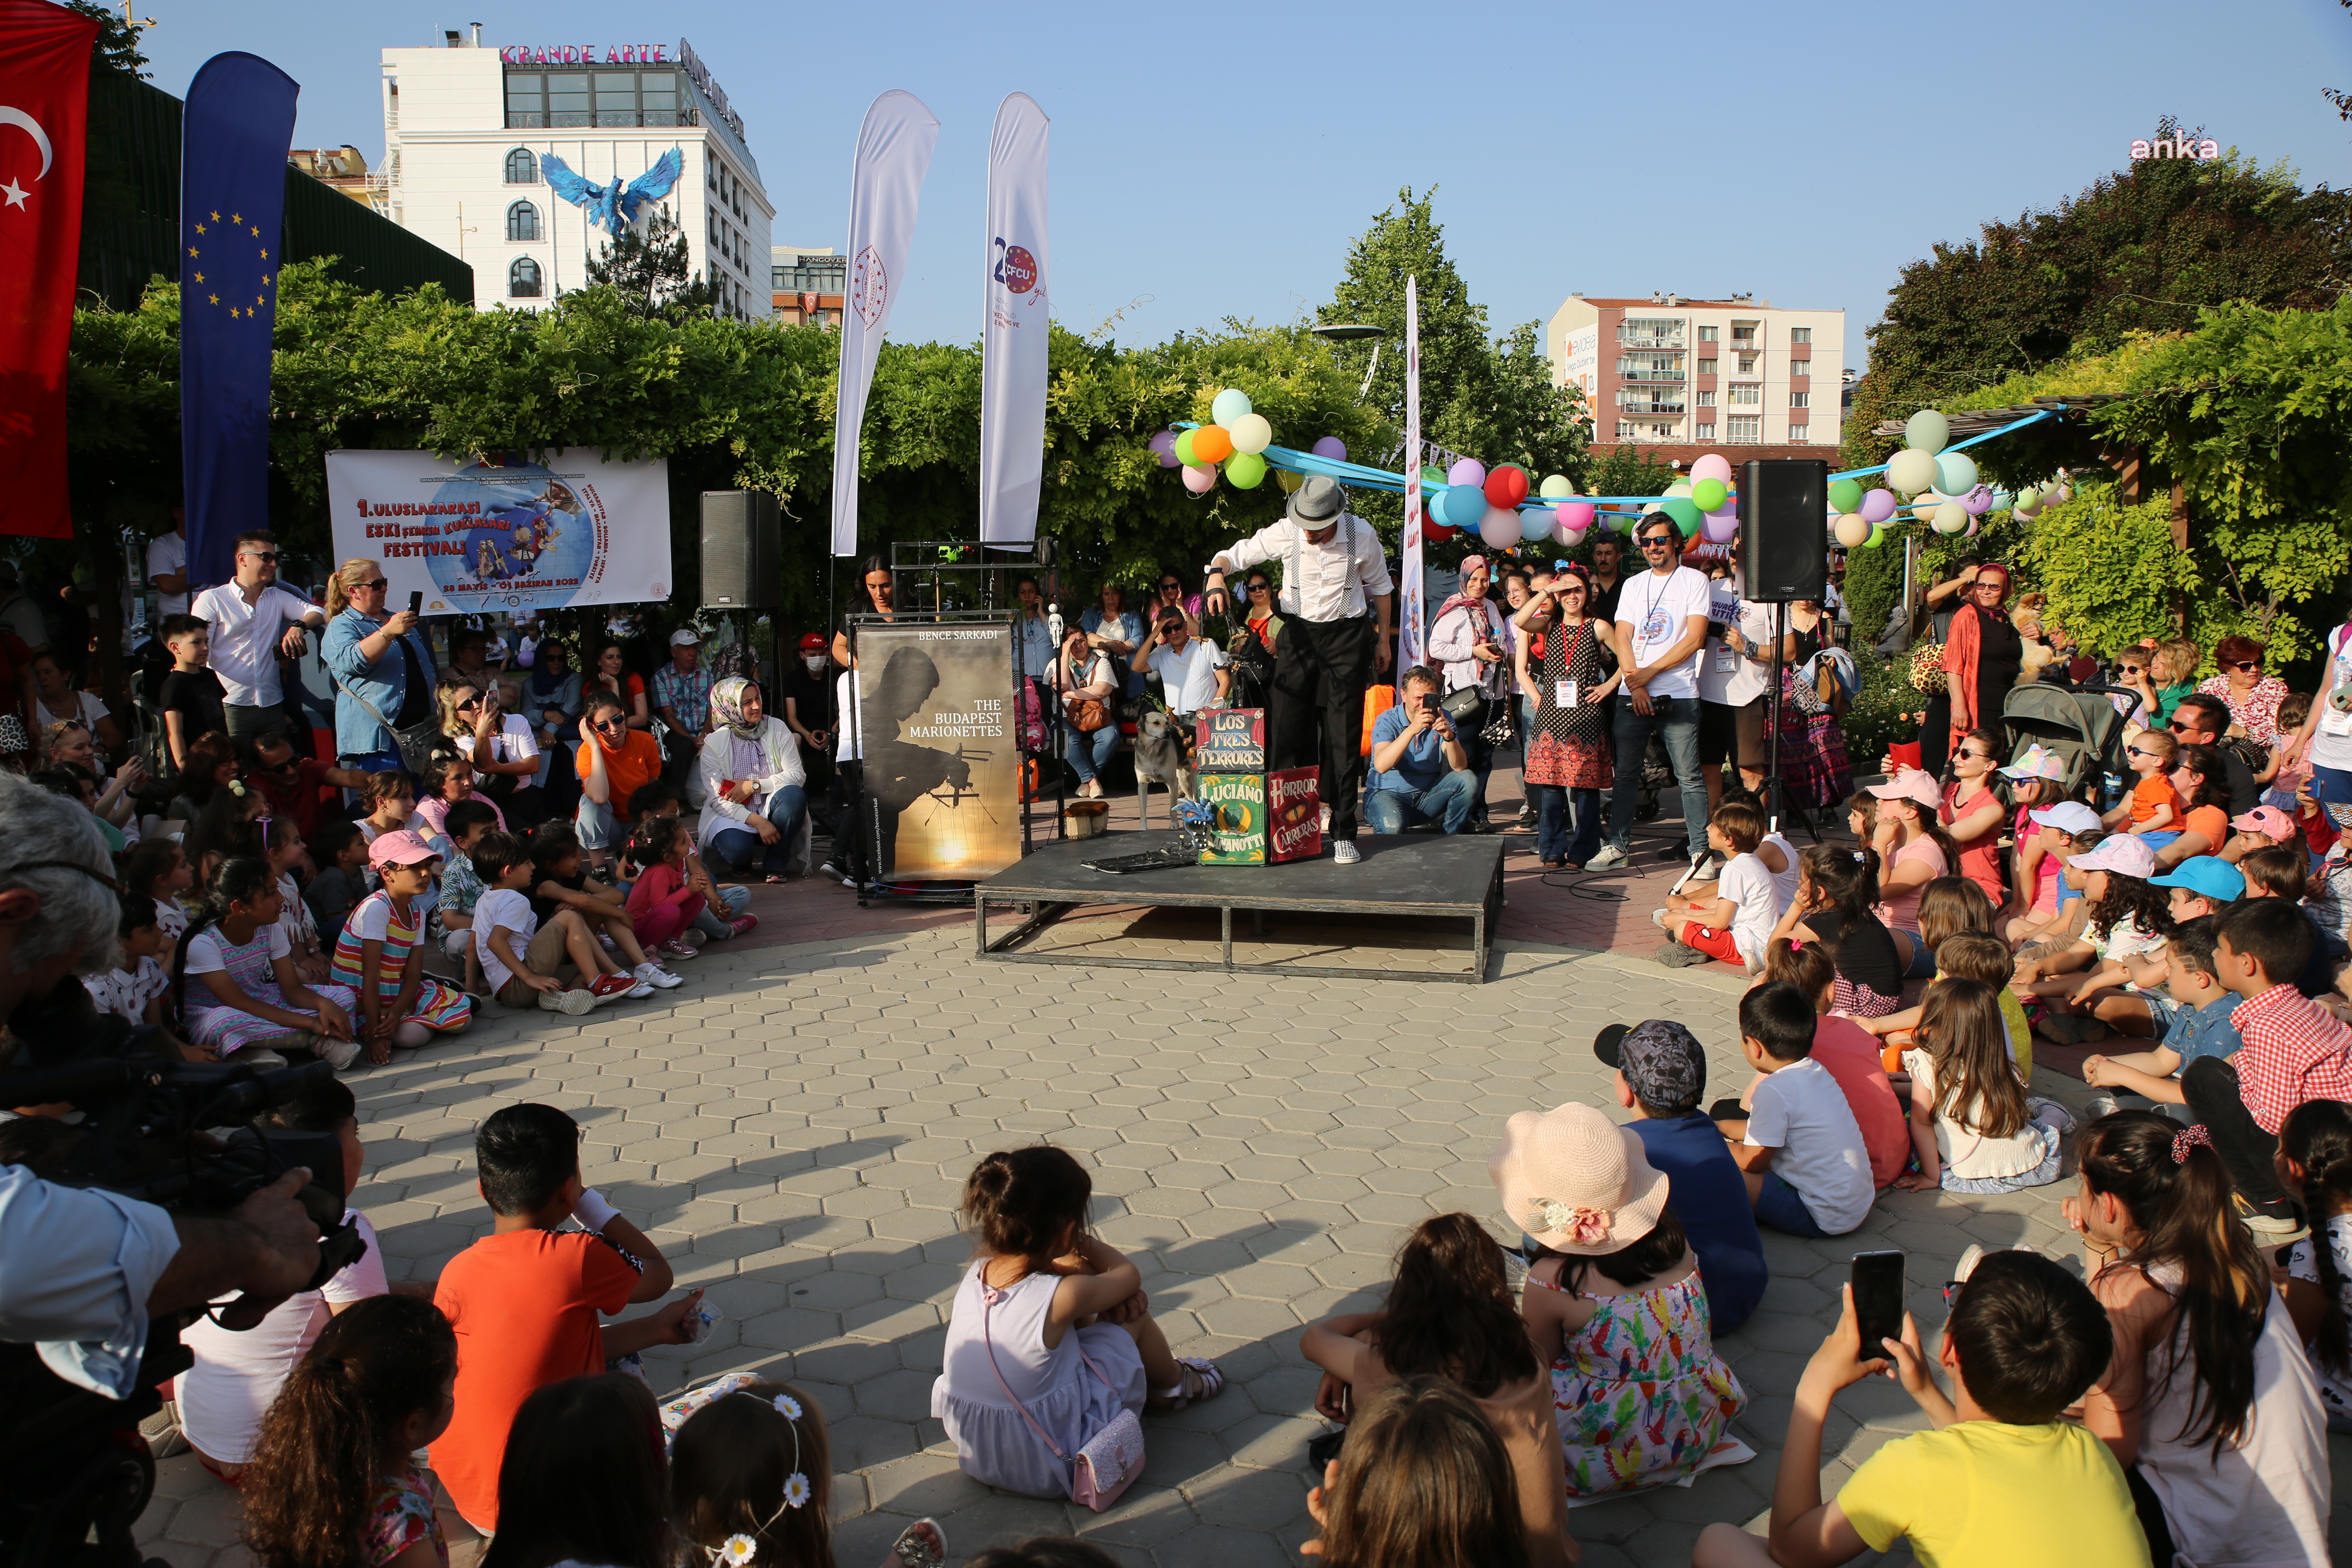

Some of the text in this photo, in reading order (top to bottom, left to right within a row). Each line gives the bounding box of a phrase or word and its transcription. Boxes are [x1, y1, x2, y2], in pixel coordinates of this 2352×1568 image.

[501, 45, 667, 63] GRANDE ARTE
[1007, 264, 1030, 280] CFCU
[1573, 334, 1596, 355] evidea
[1566, 363, 1576, 373] Vega
[442, 517, 511, 535] KUKLALARI
[556, 578, 579, 586] 2022
[1712, 609, 1734, 620] RITIC
[919, 630, 998, 641] BENCE SARKADI
[974, 699, 1001, 711] THE
[935, 712, 1002, 724] BUDAPEST
[1215, 713, 1245, 731] LOS
[910, 725, 1002, 737] MARIONETTES
[1211, 733, 1250, 750] TRES
[1197, 748, 1265, 768] TERRORES
[1199, 783, 1263, 806] LUCIANO
[1270, 778, 1319, 809] HORROR
[873, 797, 882, 874] www.facebook.com/bencesarkadi
[1272, 817, 1319, 854] CARRERAS
